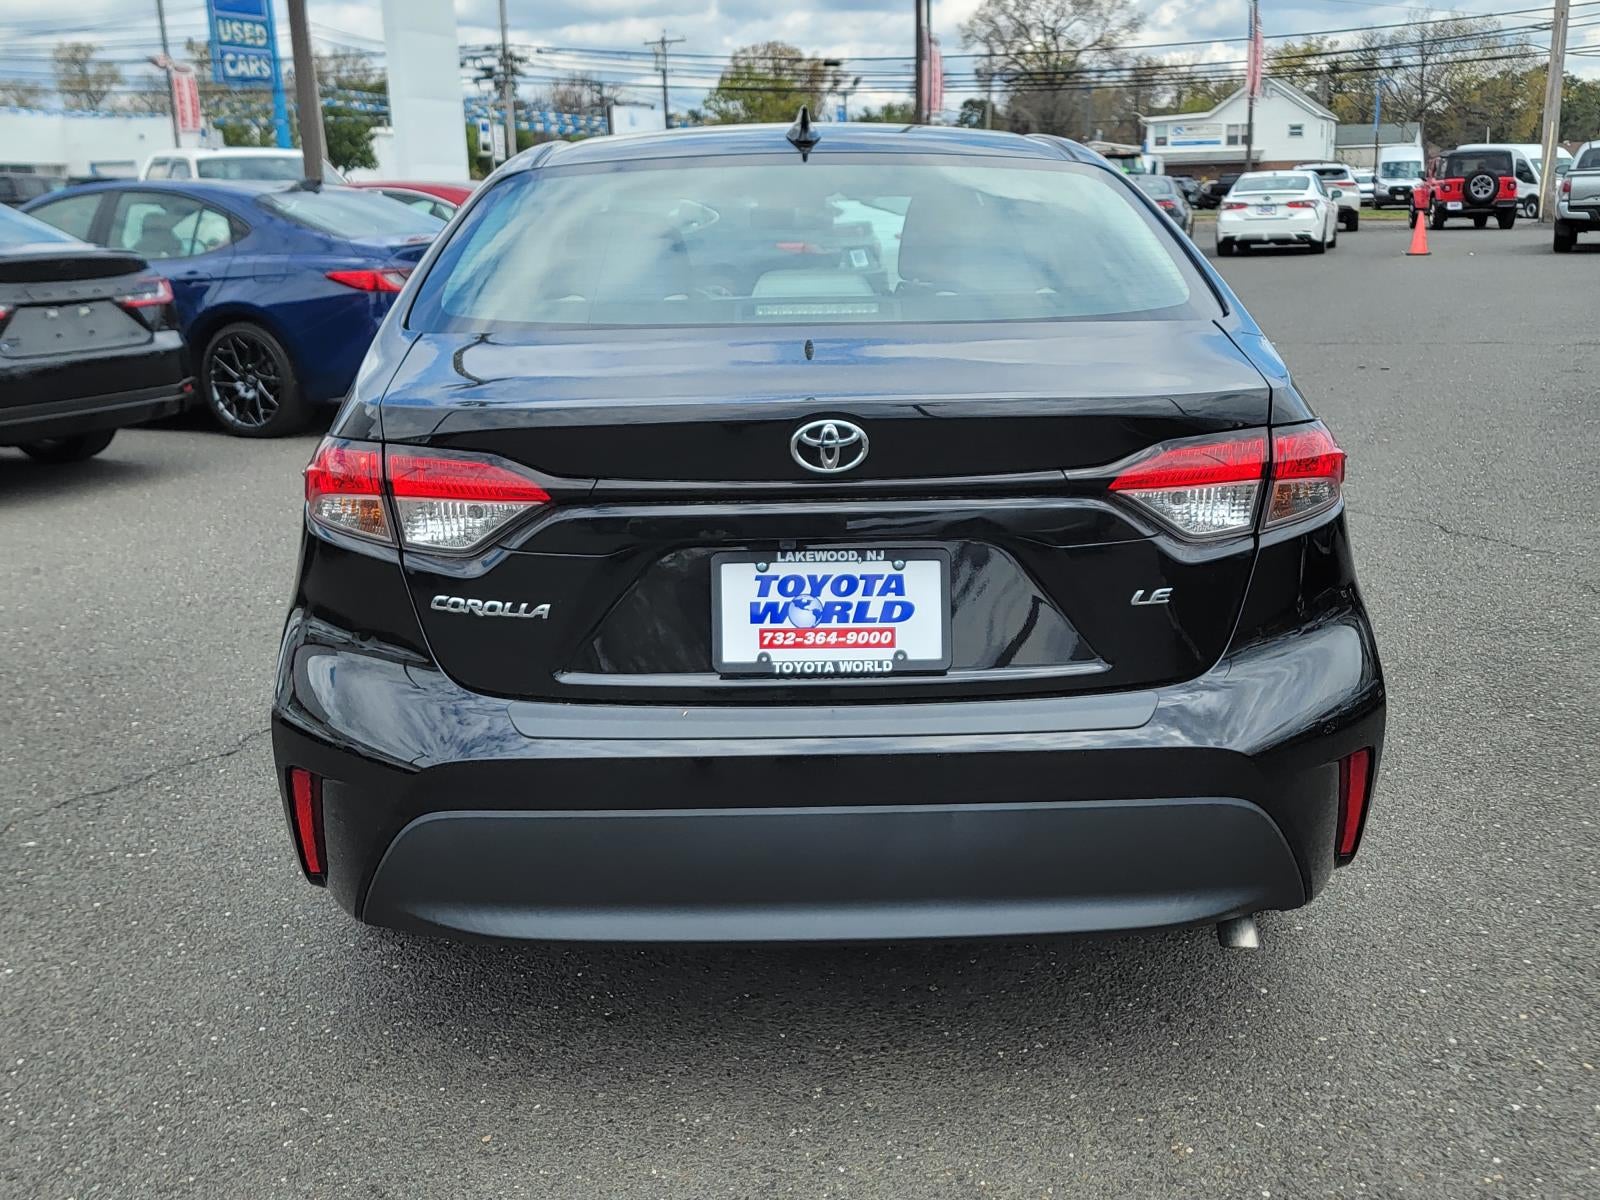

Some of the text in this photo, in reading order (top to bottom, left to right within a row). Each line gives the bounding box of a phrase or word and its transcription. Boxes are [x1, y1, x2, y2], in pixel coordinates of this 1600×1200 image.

[218, 18, 268, 47] USED
[223, 52, 271, 78] CARS
[776, 550, 885, 563] LAKEWOOD, NJ
[754, 574, 906, 598] TOYOTA
[1130, 587, 1173, 605] LE
[430, 595, 552, 619] COROLLA
[762, 631, 893, 645] 732-364-9000
[773, 660, 894, 673] TOYOTA WORLD
